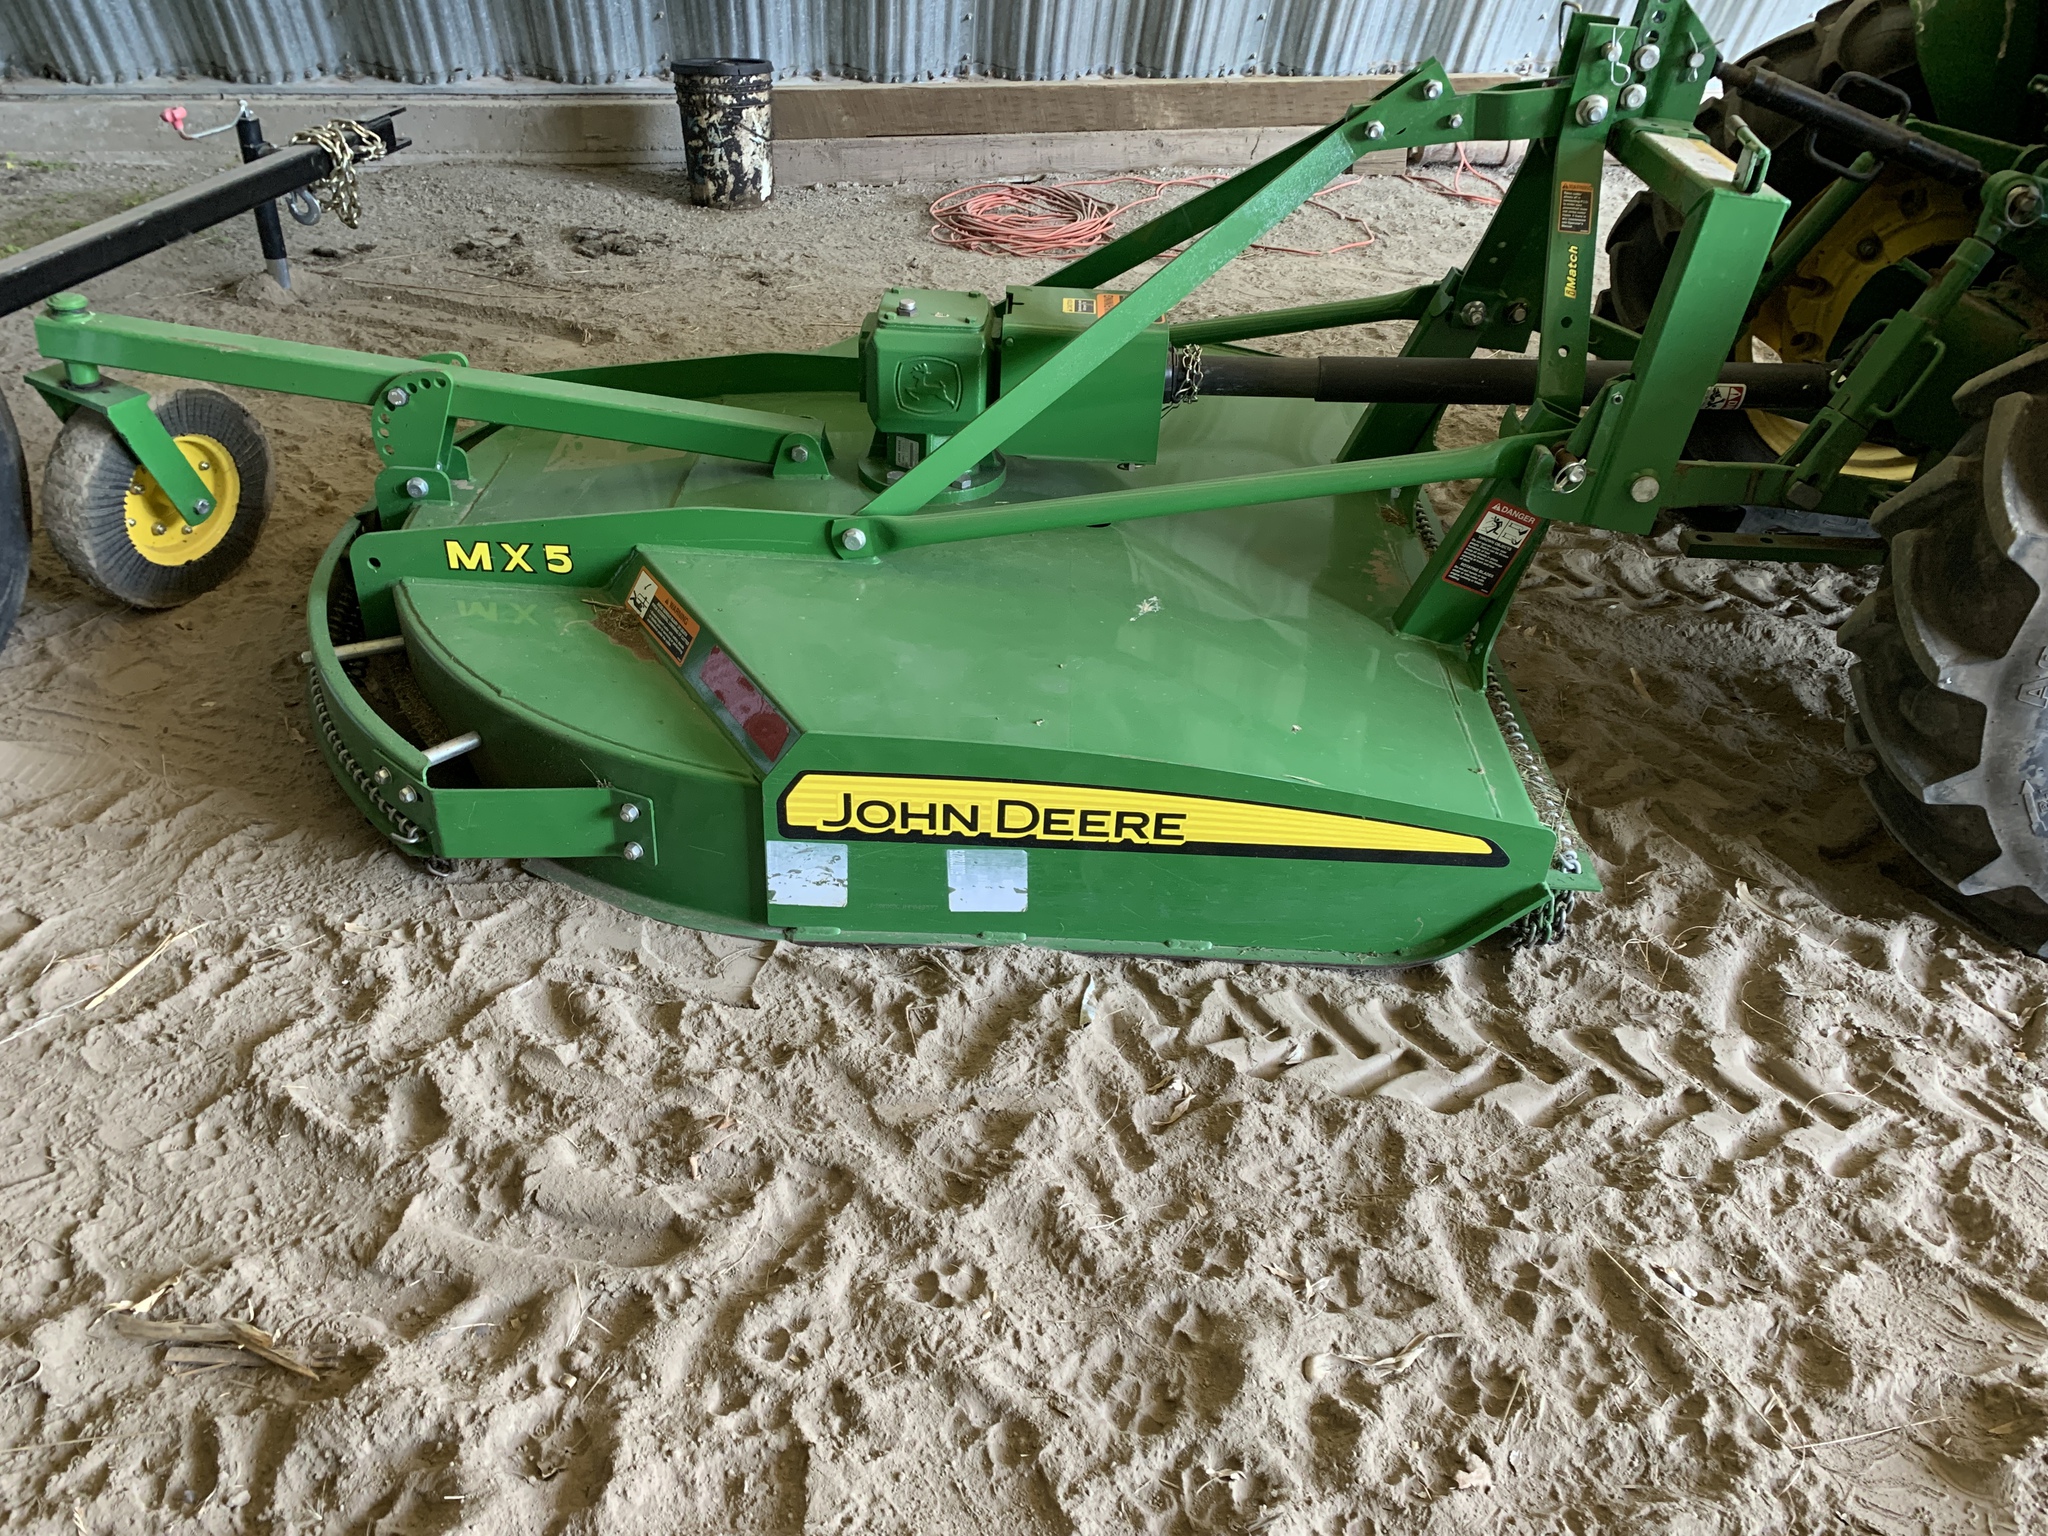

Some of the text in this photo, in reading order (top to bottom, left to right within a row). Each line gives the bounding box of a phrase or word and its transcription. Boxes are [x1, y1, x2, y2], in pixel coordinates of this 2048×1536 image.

[1501, 506, 1536, 525] DANGER
[669, 600, 688, 626] WARNING
[822, 792, 1187, 841] JOHN DEERE
